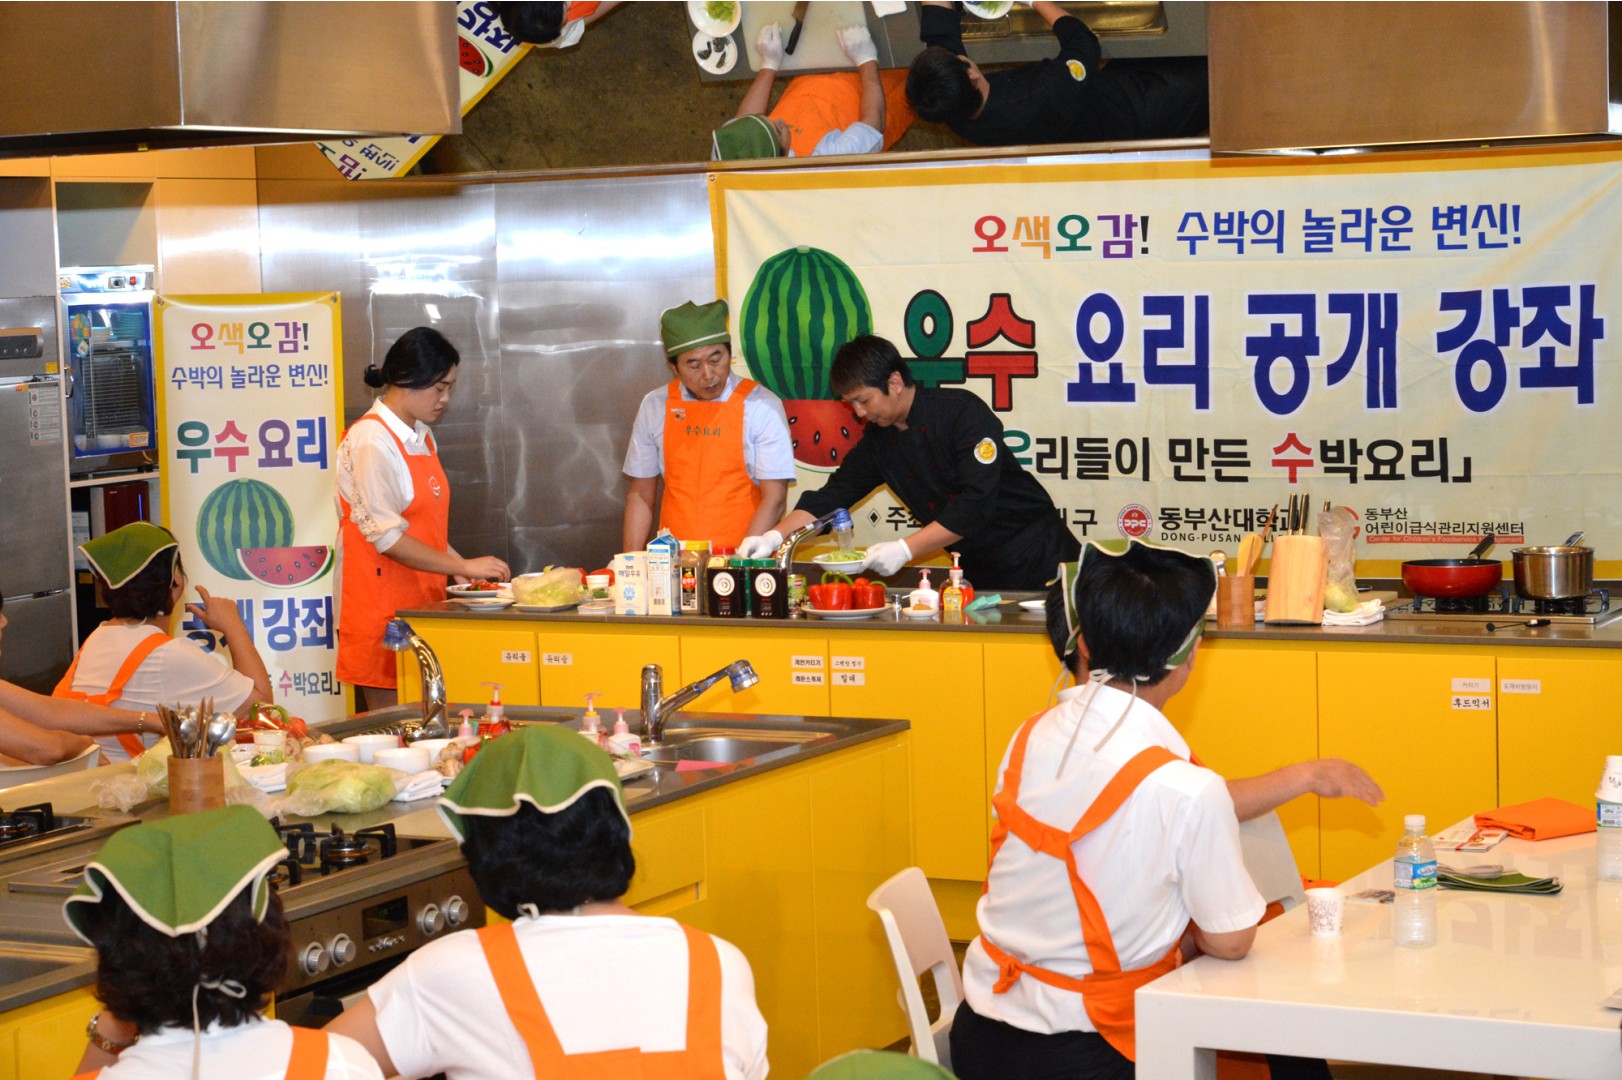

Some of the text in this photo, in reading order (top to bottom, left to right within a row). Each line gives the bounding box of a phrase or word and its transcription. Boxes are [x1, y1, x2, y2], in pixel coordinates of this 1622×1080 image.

[972, 203, 1522, 260] 오색오감! 수박의 놀라운 변신!
[190, 321, 309, 355] 오색오감!
[1066, 293, 1210, 410] 요리
[1245, 293, 1399, 416] 공개
[1436, 284, 1604, 413] 강좌
[171, 363, 329, 390] 수박의 놀라운 변신!
[1168, 437, 1251, 483] 만든
[1270, 432, 1472, 485] 수박요리」
[1365, 507, 1408, 521] 동부산
[1365, 521, 1524, 535] 어린이급식관리지원센터
[1161, 532, 1241, 543] DONG-PUSAN
[262, 595, 334, 652] 강좌
